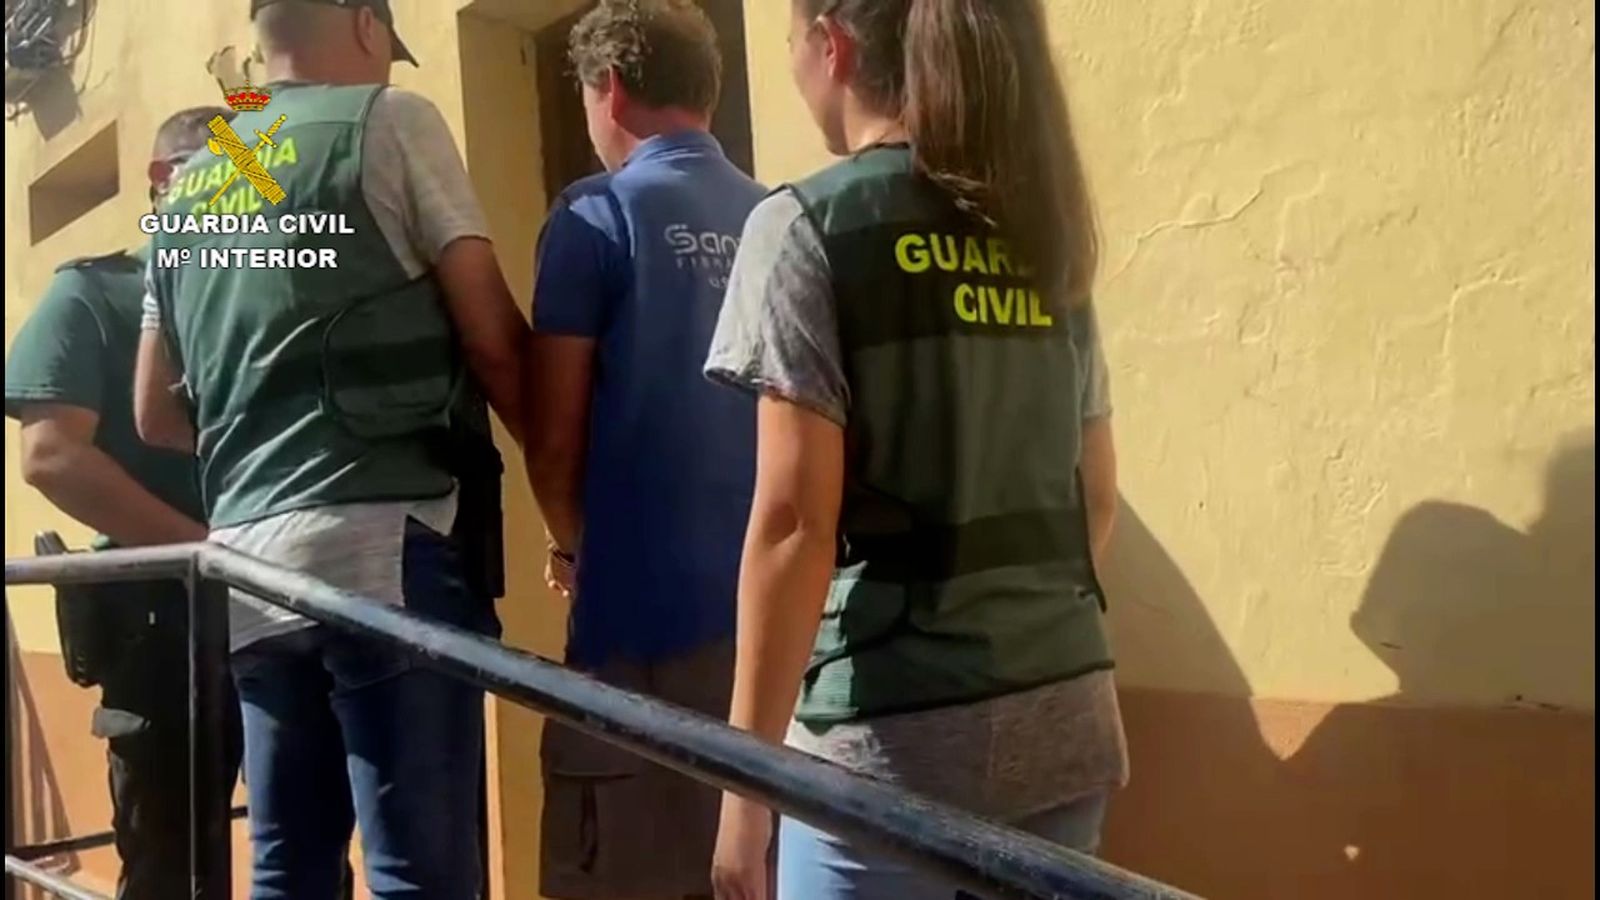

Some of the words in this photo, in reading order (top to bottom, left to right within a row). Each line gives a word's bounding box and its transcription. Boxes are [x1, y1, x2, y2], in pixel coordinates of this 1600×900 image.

[664, 224, 741, 255] San
[895, 233, 1036, 277] GUAR
[953, 283, 1053, 327] CIVIL
